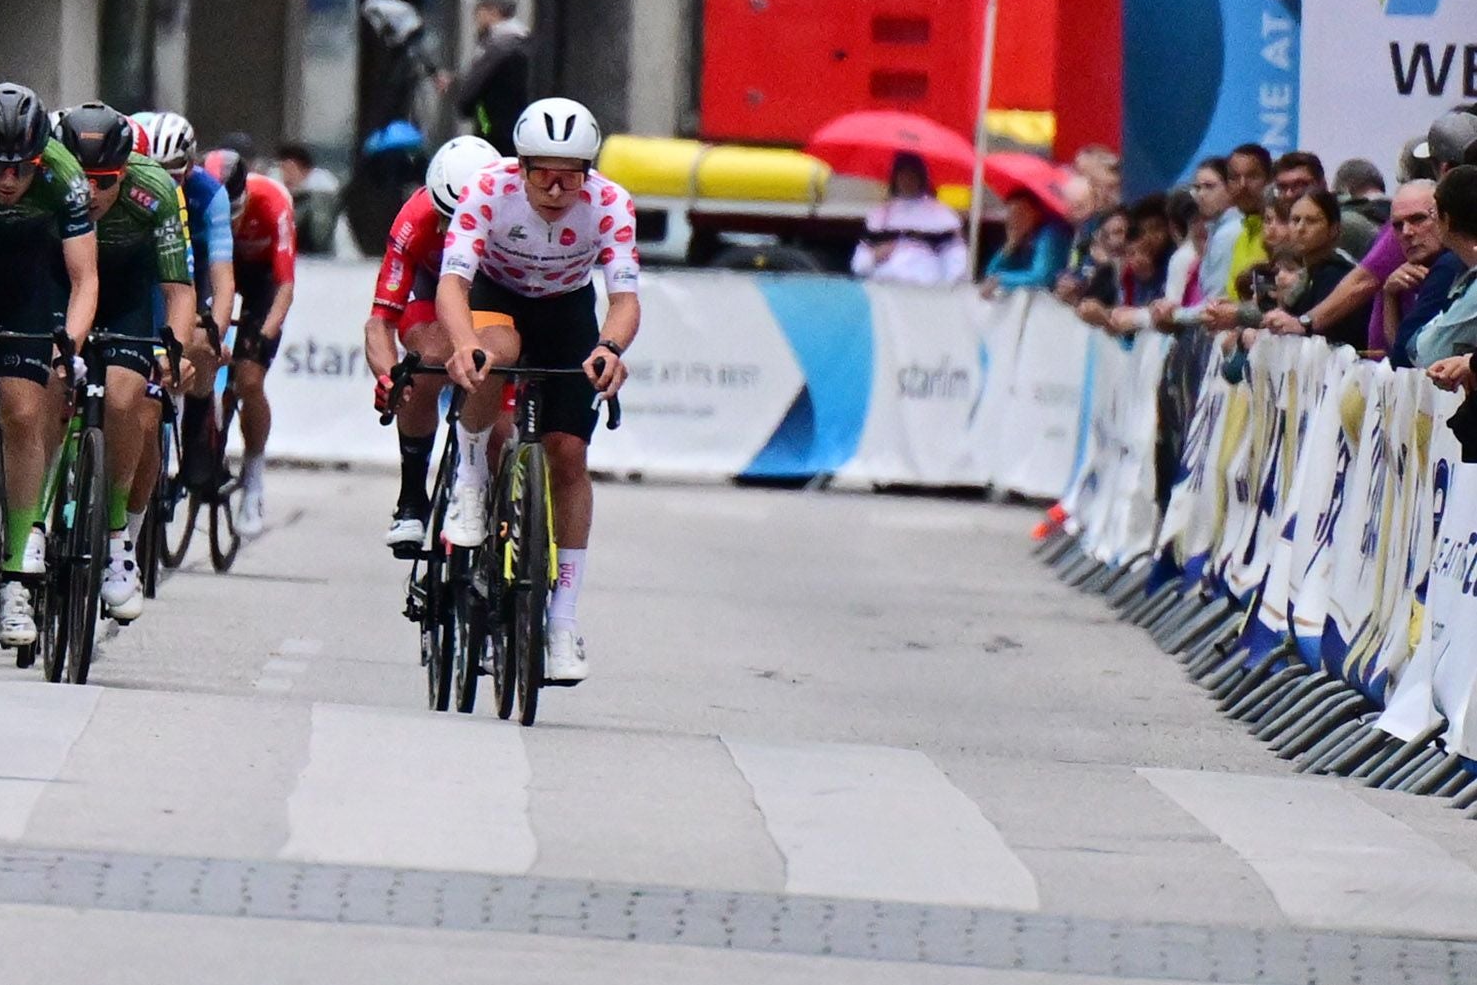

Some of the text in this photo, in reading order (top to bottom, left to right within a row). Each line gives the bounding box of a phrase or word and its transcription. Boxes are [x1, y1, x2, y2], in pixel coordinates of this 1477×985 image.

[1260, 10, 1292, 69] AT
[1259, 81, 1292, 154] NE
[285, 337, 369, 377] star
